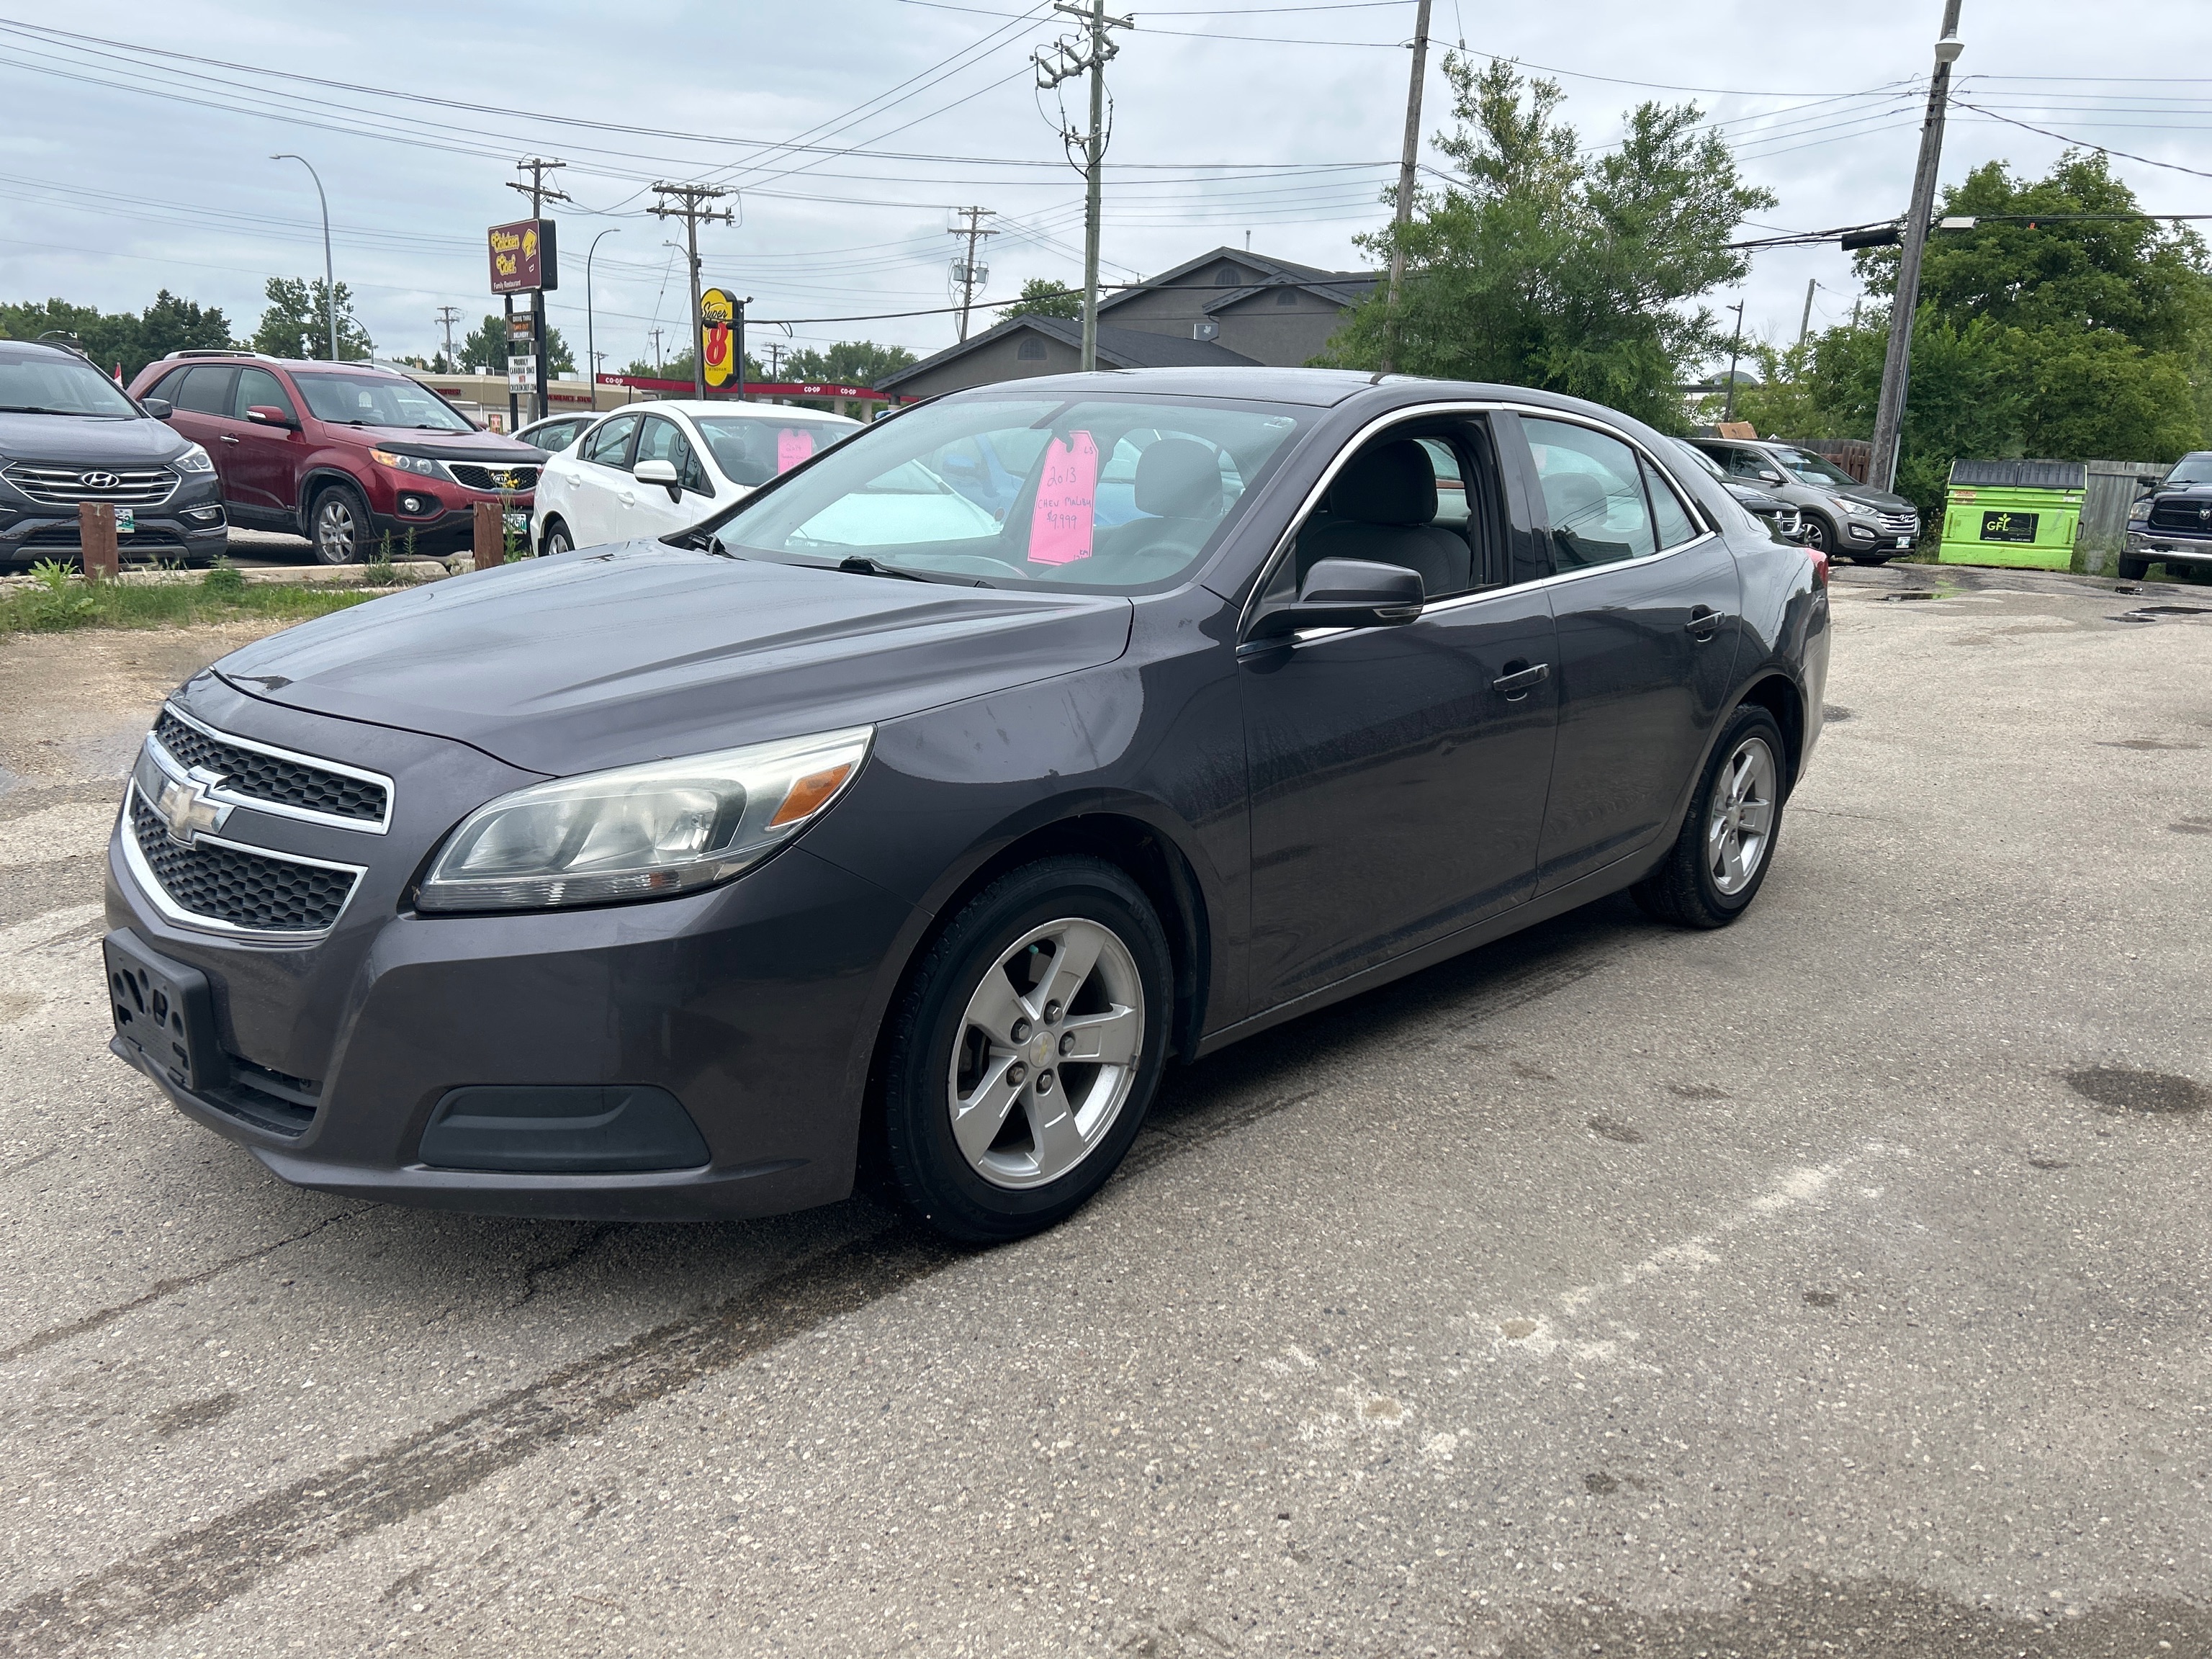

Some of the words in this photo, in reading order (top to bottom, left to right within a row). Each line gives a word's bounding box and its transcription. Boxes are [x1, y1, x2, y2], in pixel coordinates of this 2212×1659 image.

[491, 230, 520, 253] Chicken
[493, 282, 504, 290] Family
[504, 279, 521, 288] Restaurant
[703, 301, 728, 318] Super
[705, 321, 728, 367] 8
[1047, 466, 1077, 487] 2013
[1038, 498, 1060, 509] CHEV
[1987, 518, 2011, 531] GFL
